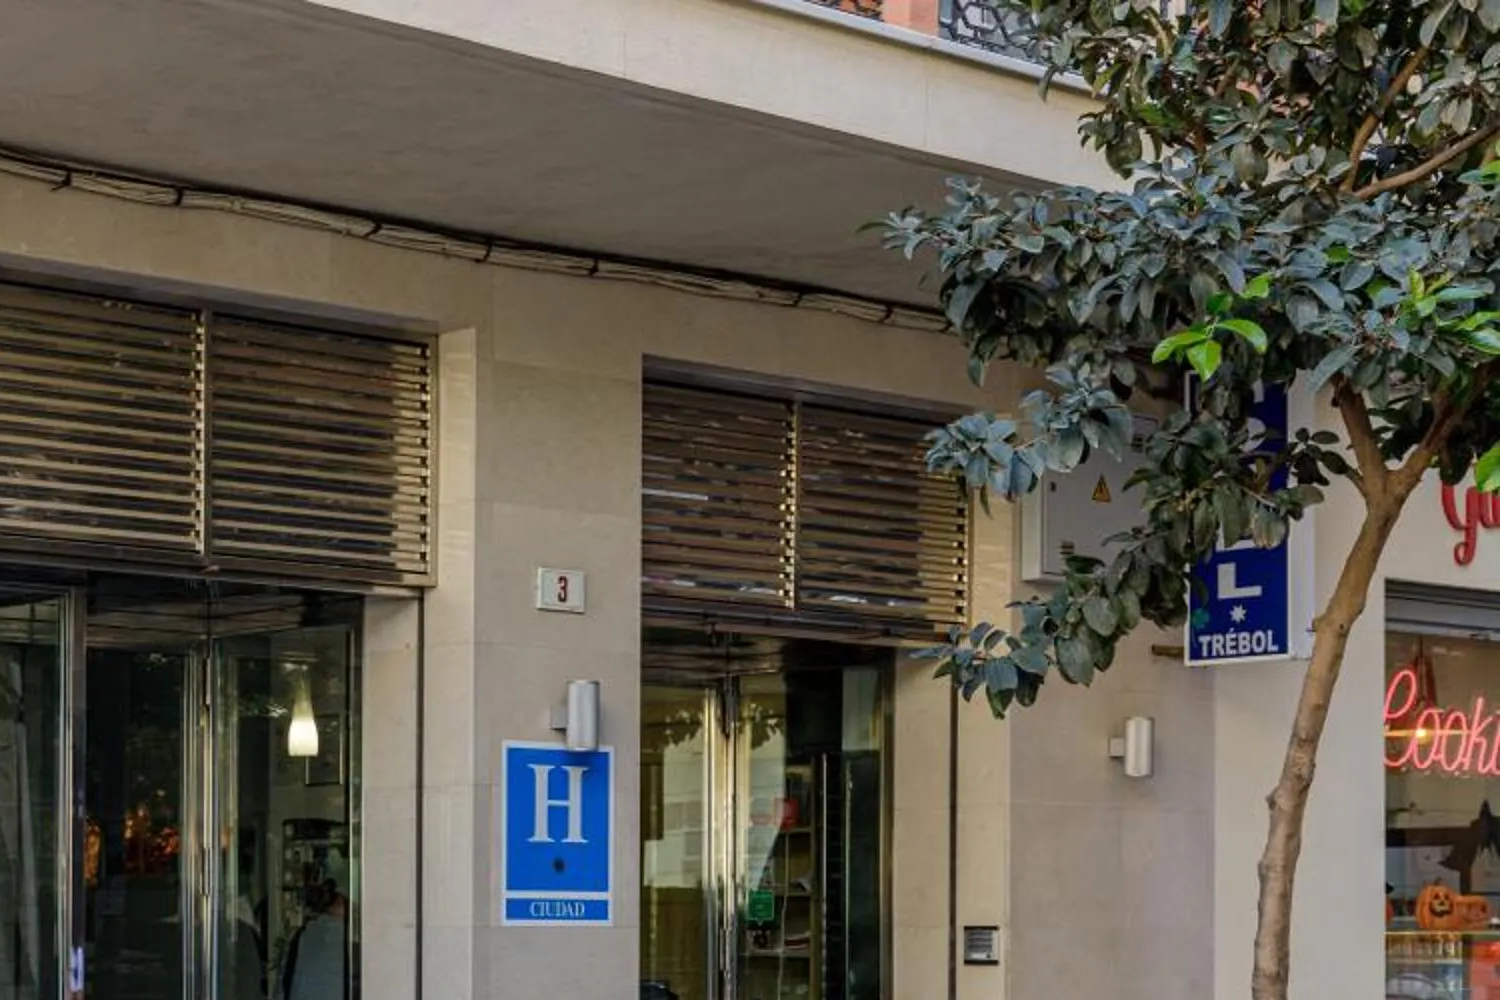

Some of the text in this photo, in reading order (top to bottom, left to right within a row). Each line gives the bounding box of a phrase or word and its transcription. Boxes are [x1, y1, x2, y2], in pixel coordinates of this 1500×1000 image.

[557, 575, 568, 603] 3
[1198, 627, 1279, 657] TRÉBOL
[526, 763, 590, 844] H
[529, 901, 585, 917] CIUDAD
